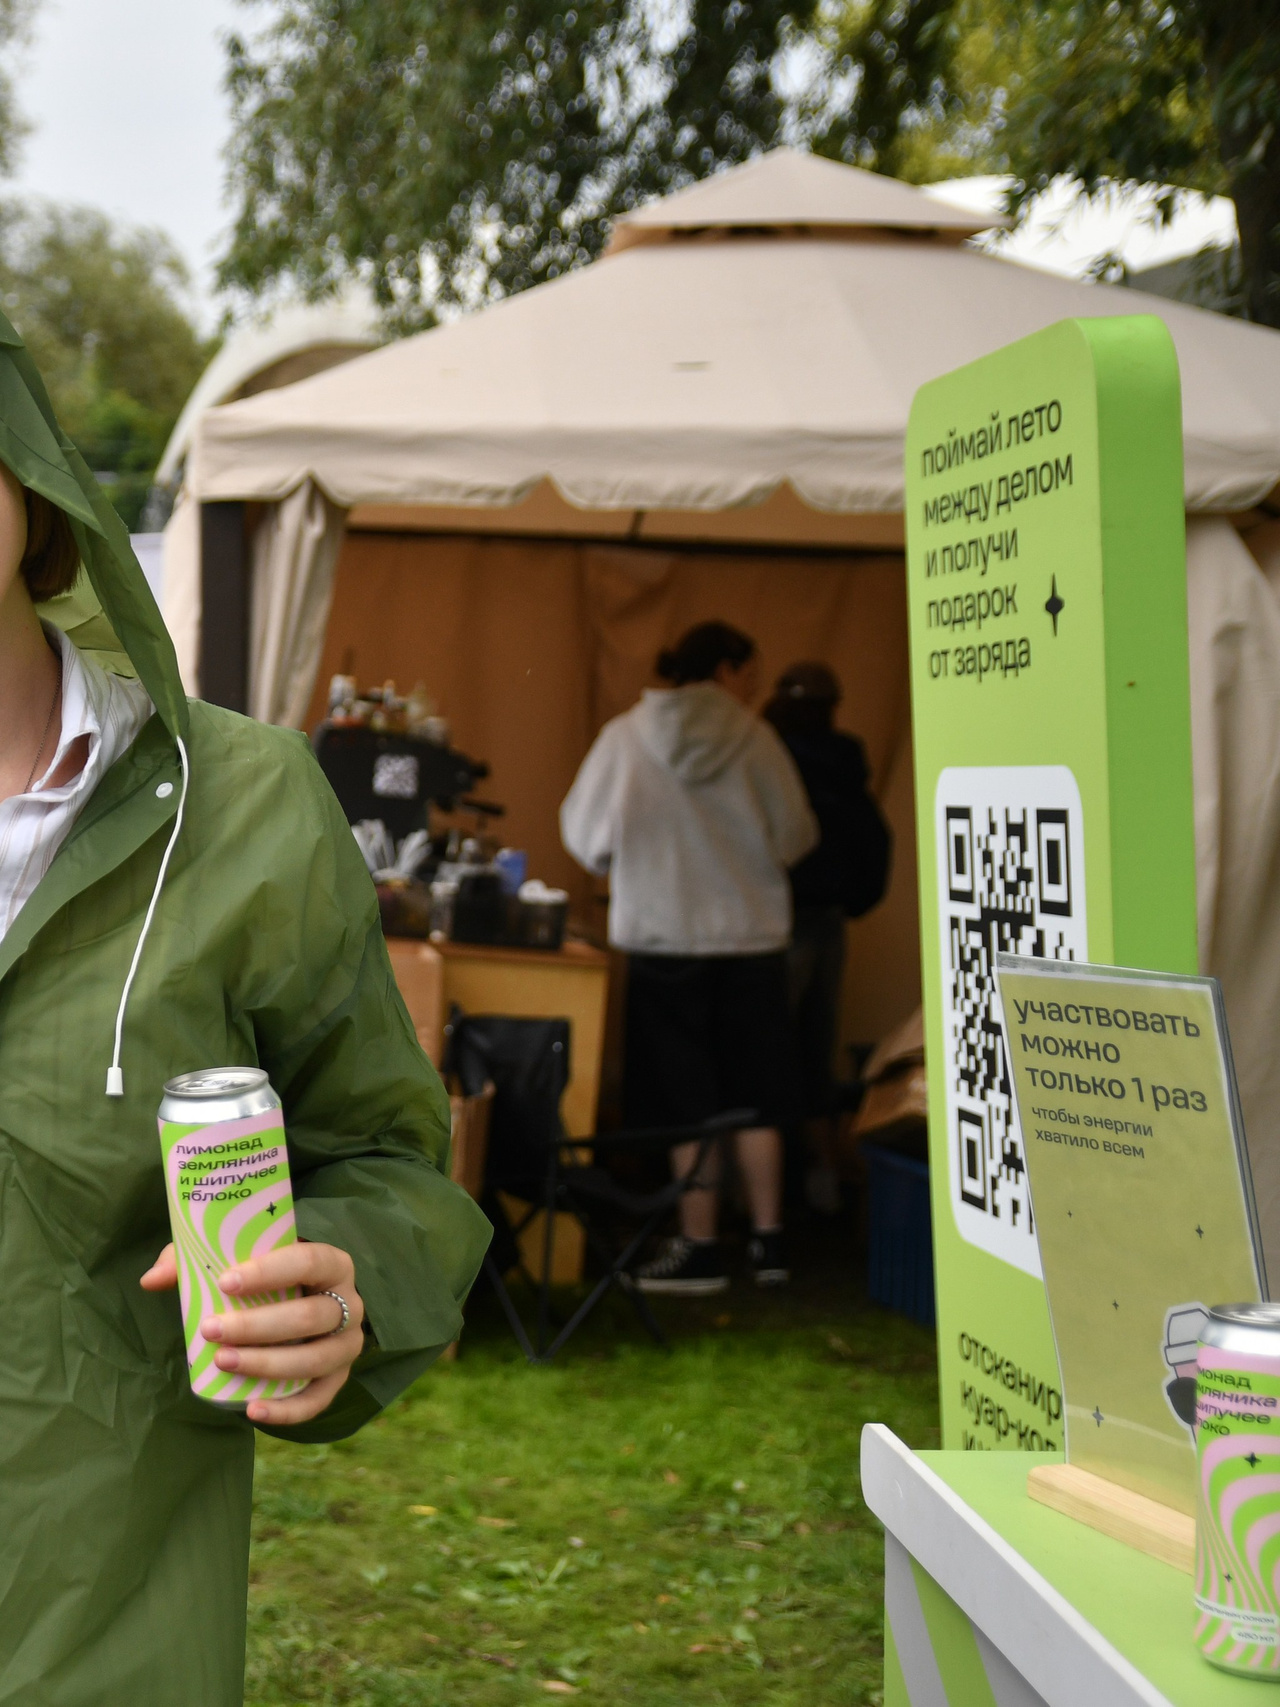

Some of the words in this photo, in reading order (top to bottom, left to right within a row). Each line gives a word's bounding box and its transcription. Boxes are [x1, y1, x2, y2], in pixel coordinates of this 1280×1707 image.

[922, 410, 1003, 478] поймай
[1006, 399, 1062, 449] лето
[923, 479, 993, 529] между
[996, 453, 1073, 515] делом
[926, 549, 938, 578] и
[942, 527, 1019, 576] получи
[928, 583, 1019, 632] подарок
[929, 648, 951, 679] от
[954, 637, 1032, 683] заряда
[1013, 999, 1201, 1038] участвовать
[1020, 1033, 1120, 1064] можно
[1025, 1067, 1126, 1099] только
[1131, 1077, 1145, 1103] 1
[1151, 1084, 1209, 1112] раз
[1032, 1106, 1080, 1125] чтобы
[1083, 1115, 1153, 1137] энергии
[176, 1137, 264, 1155] лимонад
[178, 1147, 279, 1171] земляника
[1035, 1129, 1100, 1150] хватило
[1103, 1140, 1145, 1159] всем
[180, 1175, 190, 1185] и
[193, 1164, 278, 1186] шипучее
[182, 1188, 252, 1202] яблоко
[958, 1331, 1063, 1427] отсканир
[1197, 1366, 1252, 1390] монад
[1197, 1383, 1278, 1408] мляника
[1197, 1416, 1231, 1436] локо
